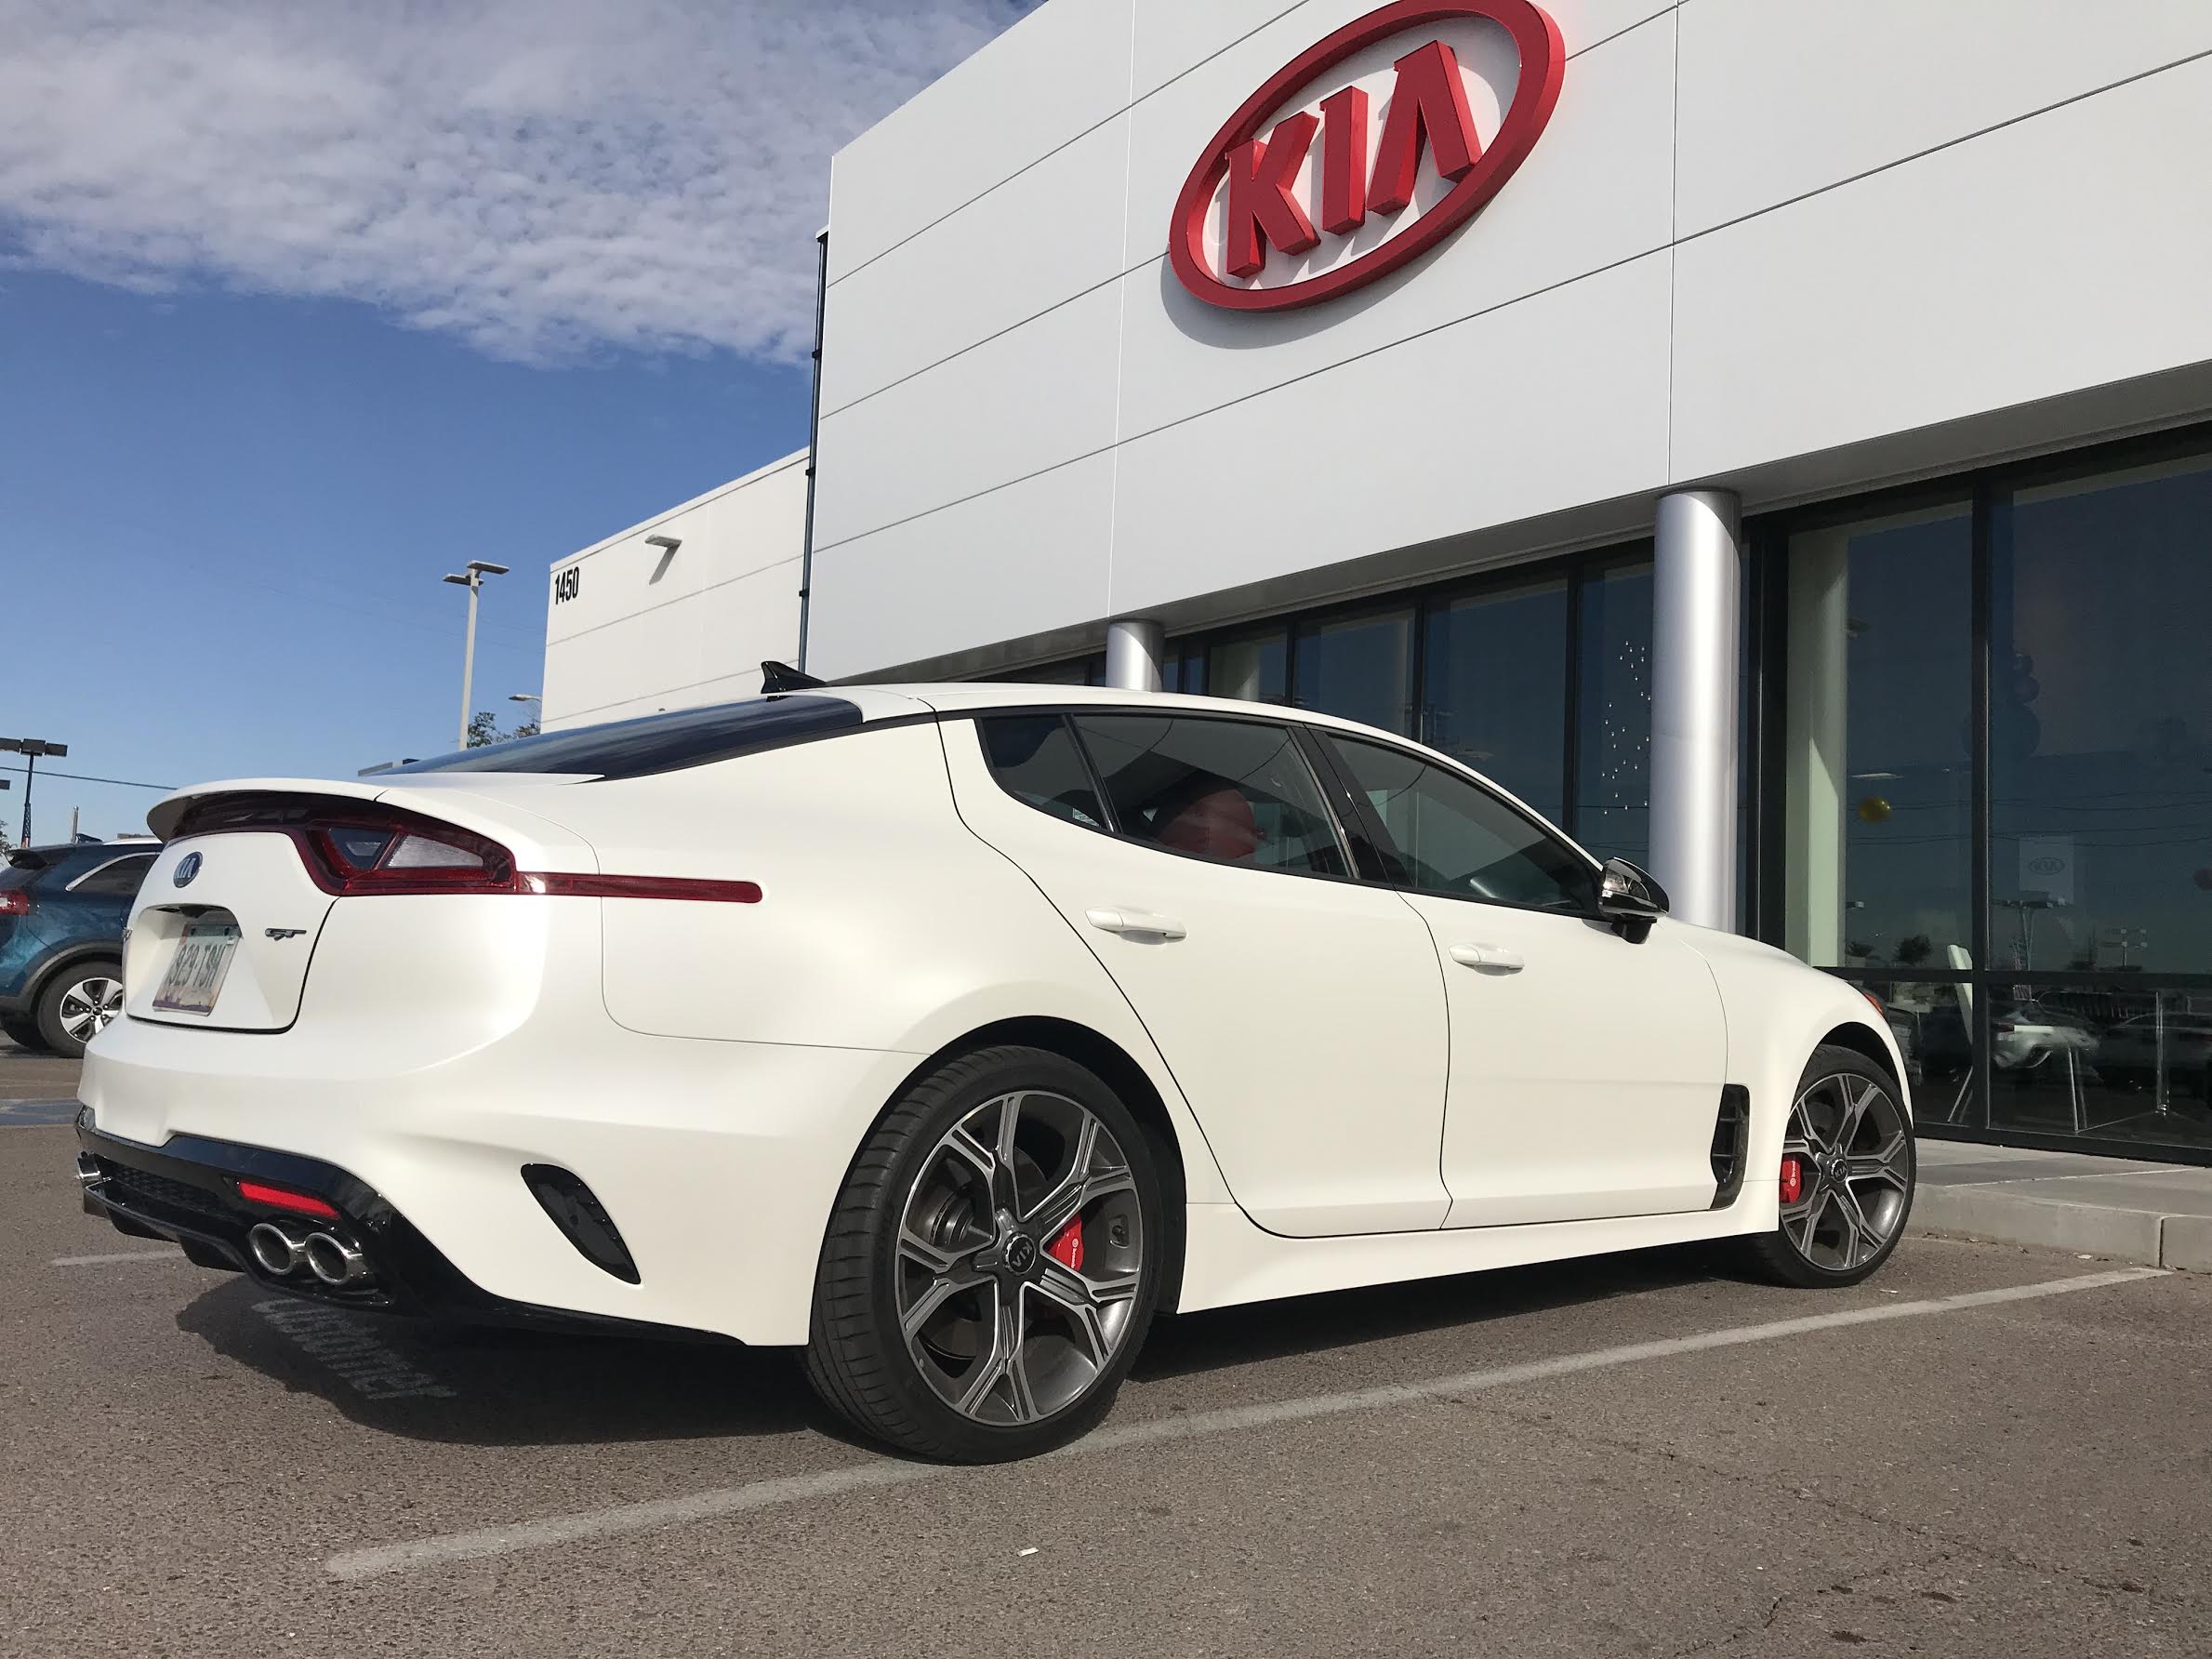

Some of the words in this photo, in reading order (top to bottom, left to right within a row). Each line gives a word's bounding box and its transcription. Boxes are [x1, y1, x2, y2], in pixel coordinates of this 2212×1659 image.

[1225, 40, 1482, 278] KIA
[555, 566, 579, 604] 1450
[1013, 1241, 1033, 1267] KIA
